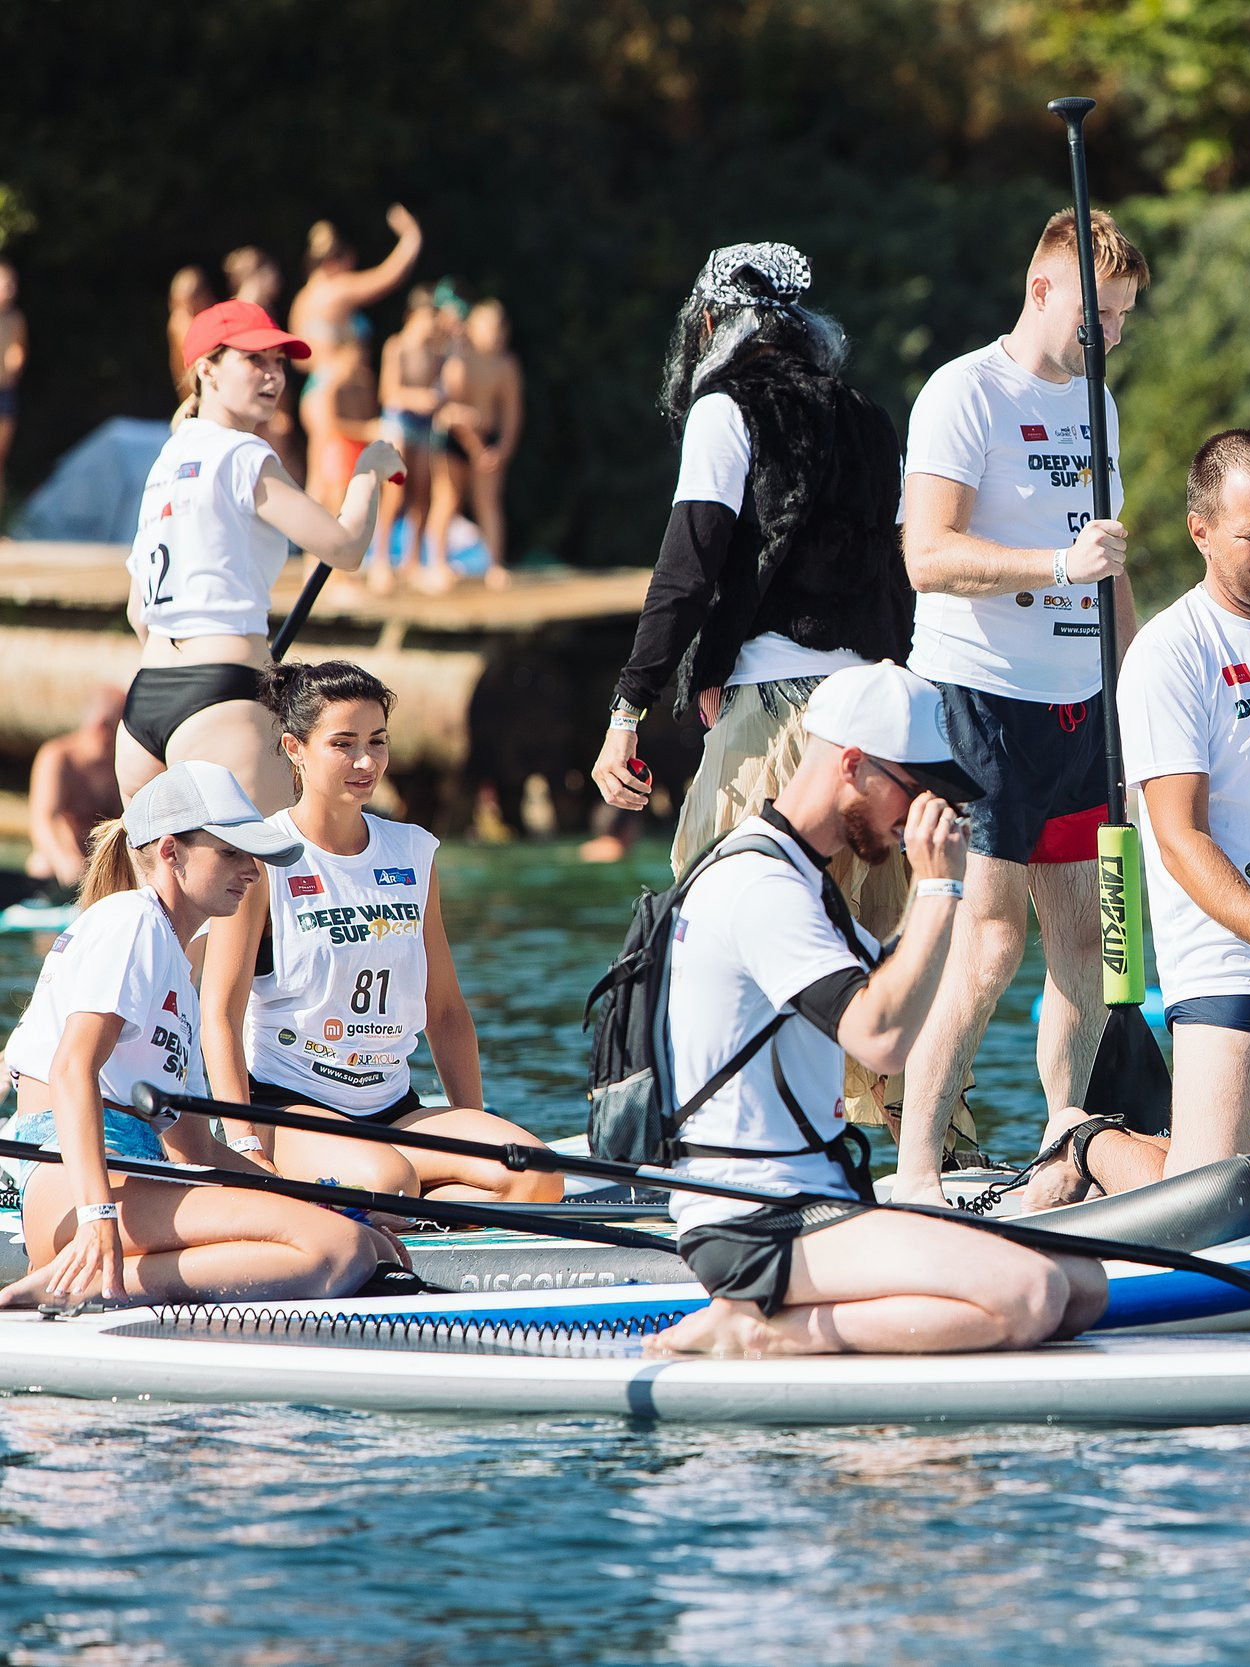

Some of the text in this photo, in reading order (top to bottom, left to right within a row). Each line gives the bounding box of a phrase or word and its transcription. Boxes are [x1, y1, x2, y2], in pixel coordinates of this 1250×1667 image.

[1028, 454, 1070, 471] DEEP
[1050, 471, 1080, 488] SUP
[143, 543, 173, 608] 2
[1060, 626, 1100, 636] www.sup4y
[297, 903, 420, 933] DEEP WATER
[329, 924, 371, 945] SUP
[350, 969, 391, 1015] 81
[346, 1022, 403, 1037] gastore.ru
